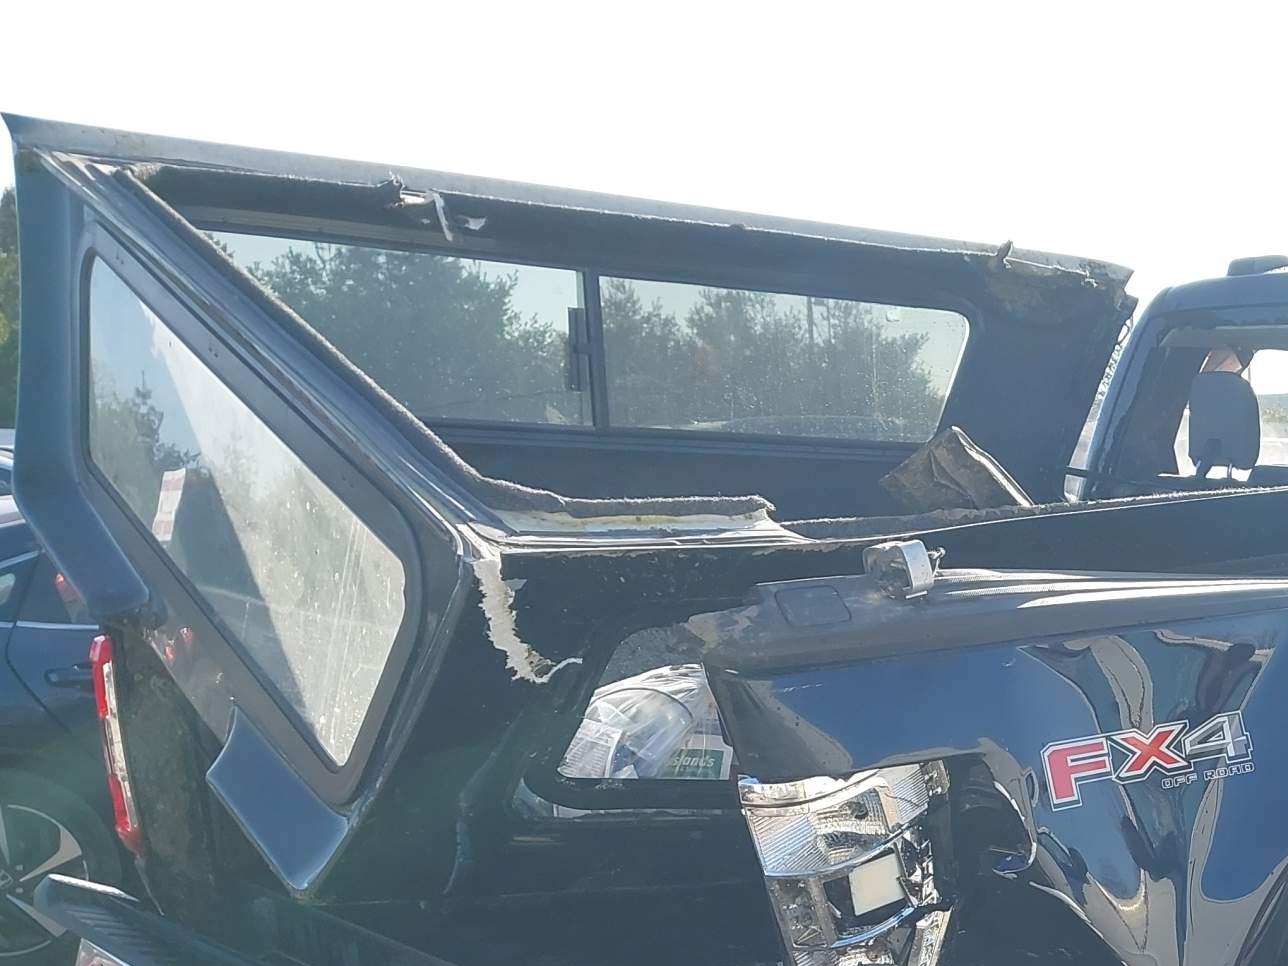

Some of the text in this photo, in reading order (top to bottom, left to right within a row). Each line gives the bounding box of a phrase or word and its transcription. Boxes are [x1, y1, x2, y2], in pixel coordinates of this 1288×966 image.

[1041, 711, 1252, 811] FX4
[1161, 762, 1254, 789] OFF ROAD
